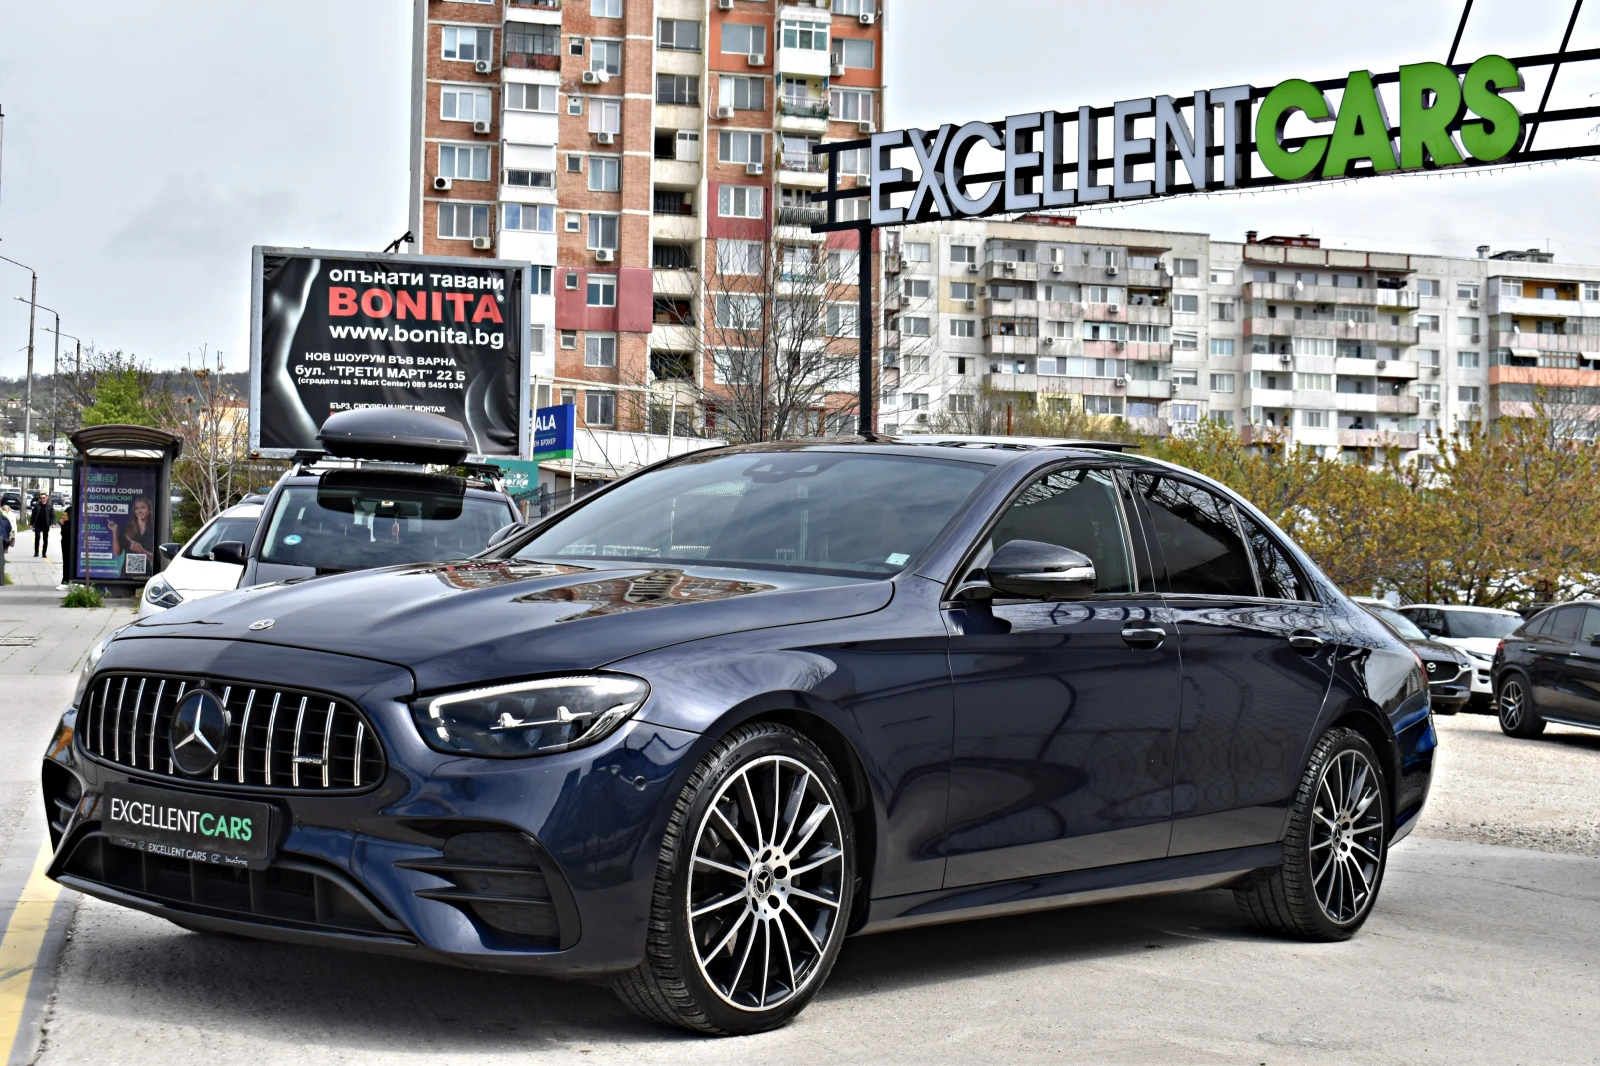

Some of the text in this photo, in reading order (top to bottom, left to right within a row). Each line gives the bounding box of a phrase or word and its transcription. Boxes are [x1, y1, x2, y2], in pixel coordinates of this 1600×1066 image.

[329, 269, 504, 291] опънати тавани
[328, 286, 504, 324] BONITA
[329, 324, 504, 349] www.bonita.bg
[305, 352, 457, 367] НОВ ШОУРУМ ВЪВ ВАРНА
[295, 365, 326, 377] бул.
[436, 370, 452, 381] 22
[456, 371, 466, 381] Б
[298, 377, 340, 386] (сградата
[381, 380, 411, 389] Center)
[428, 381, 447, 389] 5454
[449, 382, 463, 390] 934
[94, 504, 118, 513] 3000
[148, 843, 207, 862] EXCELLENT CARS
